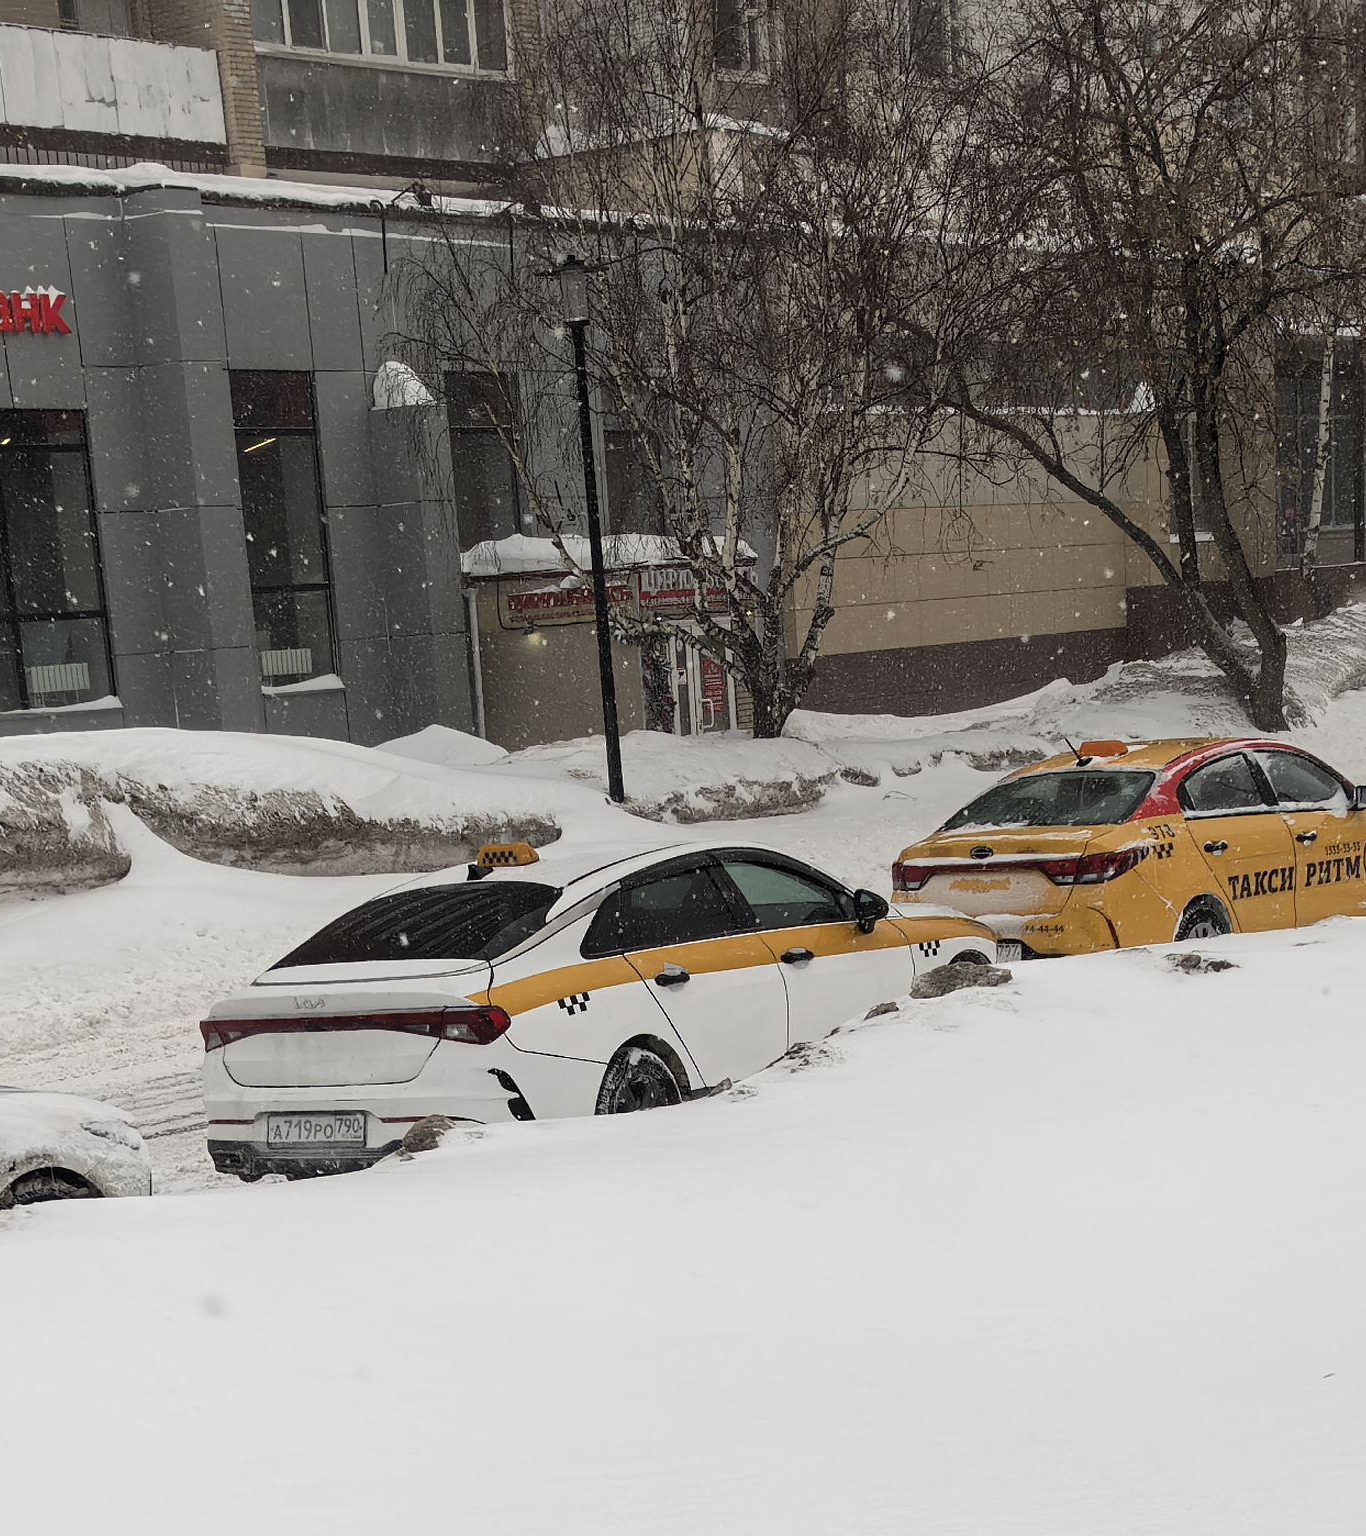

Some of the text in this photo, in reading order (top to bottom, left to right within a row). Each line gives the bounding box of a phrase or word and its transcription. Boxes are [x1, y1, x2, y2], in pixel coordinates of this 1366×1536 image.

[1228, 855, 1361, 901] ТАКСИ РИТМ
[335, 1117, 360, 1133] 790
